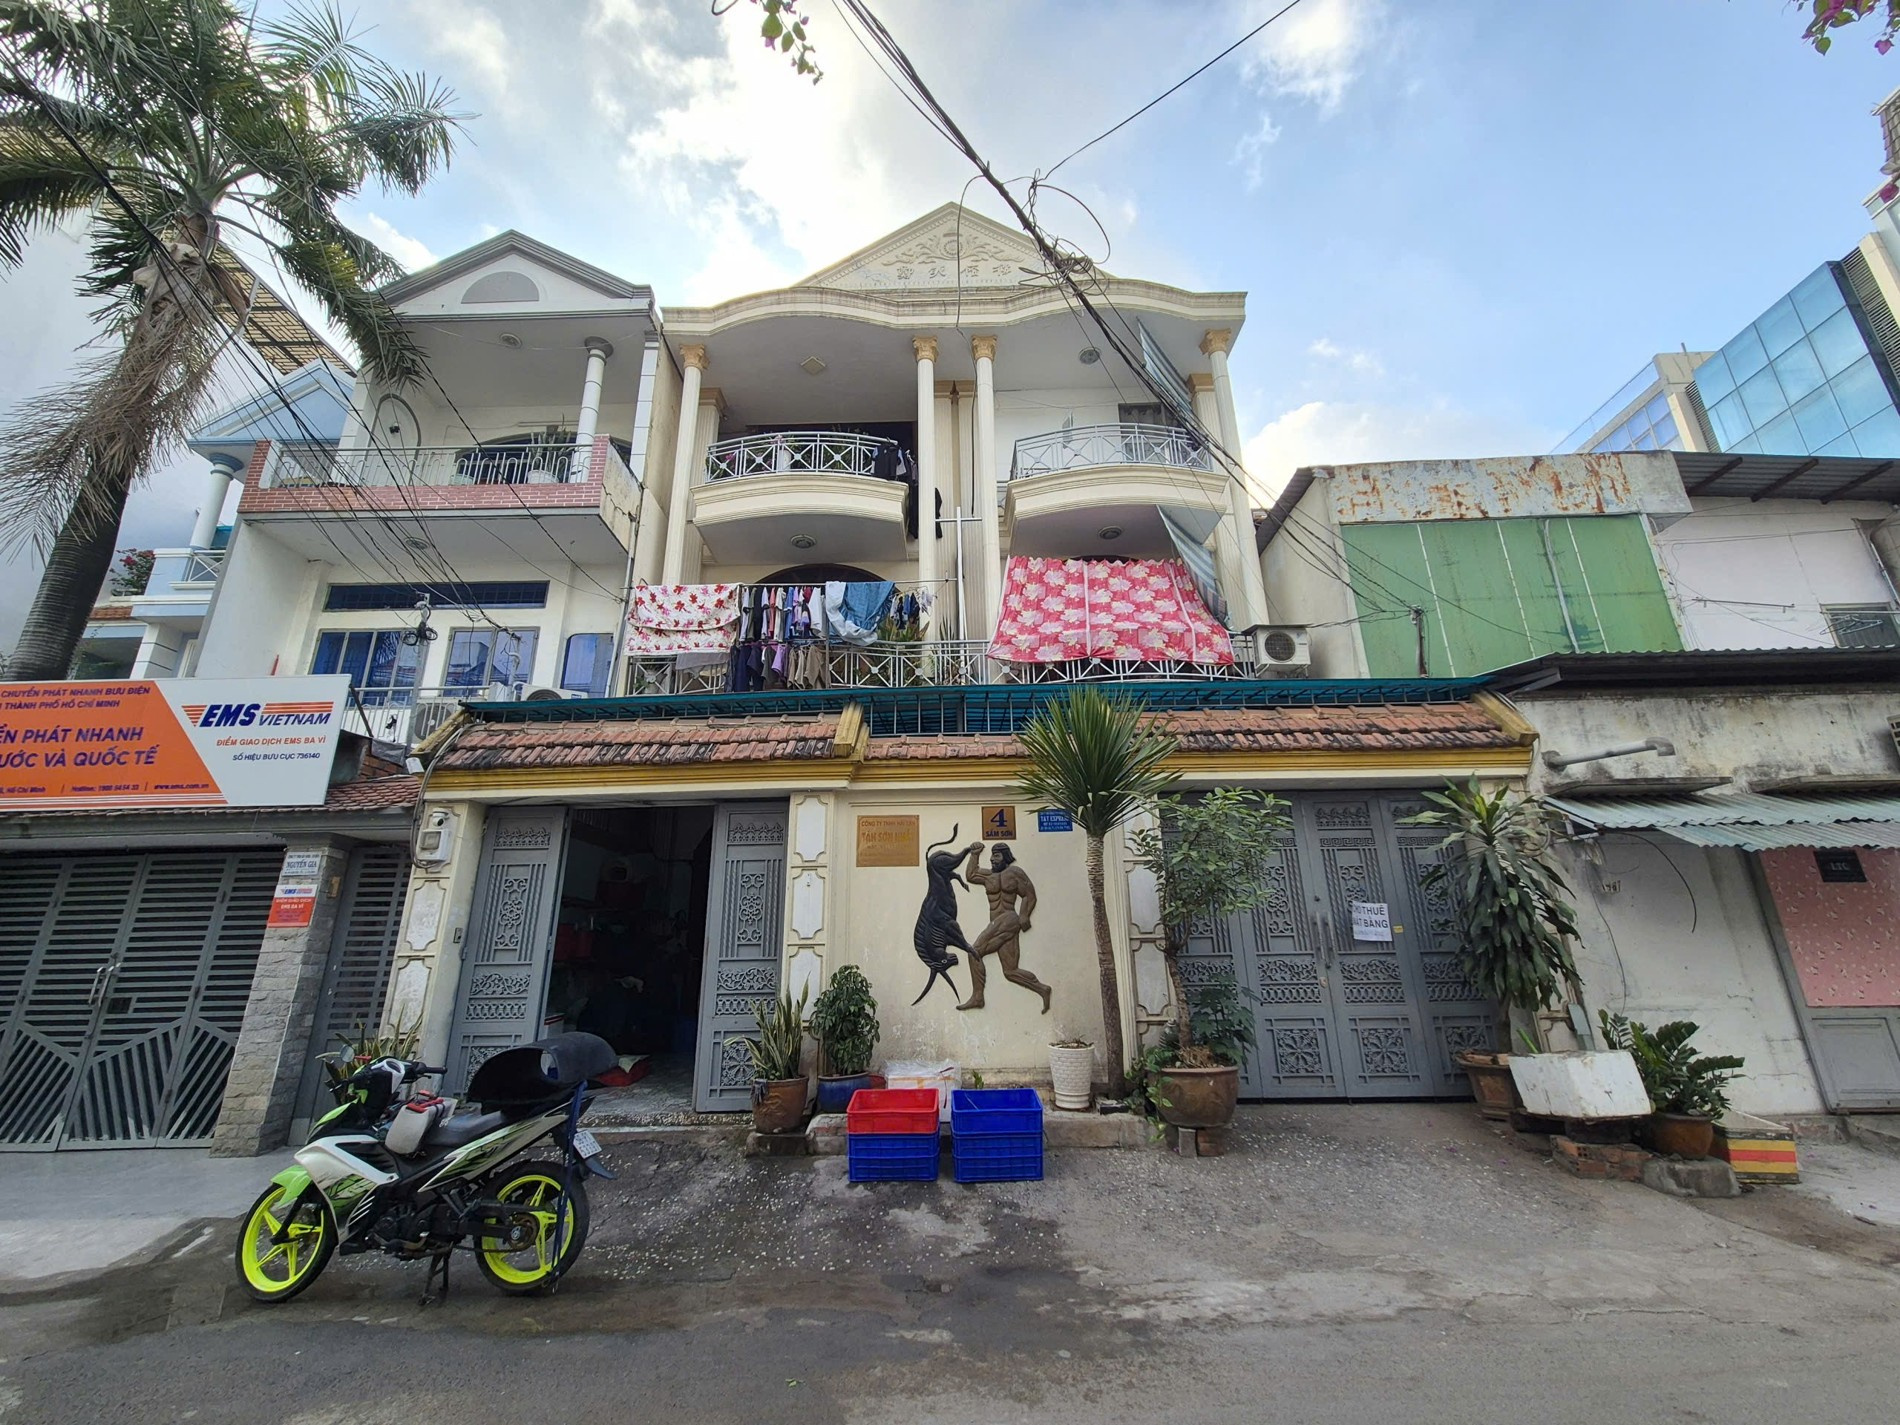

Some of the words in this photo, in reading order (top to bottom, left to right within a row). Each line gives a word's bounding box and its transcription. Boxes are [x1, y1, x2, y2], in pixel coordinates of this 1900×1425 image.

[41, 687, 68, 697] PHÁT
[69, 688, 103, 697] NHANH
[105, 687, 126, 696] BƯU
[127, 685, 150, 695] ĐIỆN
[5, 700, 37, 710] THÀNH
[38, 699, 60, 709] PHỐ
[95, 700, 121, 708] MINH
[199, 703, 261, 728] EMS
[259, 713, 331, 726] VIETNAM
[21, 724, 72, 744] PHÁT
[74, 727, 144, 743] NHANH
[216, 736, 238, 747] ĐIỂM
[239, 738, 261, 746] GIAO
[261, 738, 282, 747] DỊCH
[283, 737, 302, 745] EMS
[303, 736, 316, 744] BA
[44, 748, 66, 768] VÀ
[73, 745, 130, 767] QUỐC
[134, 744, 160, 765] TẾ
[232, 752, 244, 761] SỐ
[244, 752, 261, 761] HIỆU
[262, 753, 279, 761] BƯU
[990, 808, 1007, 828] 4
